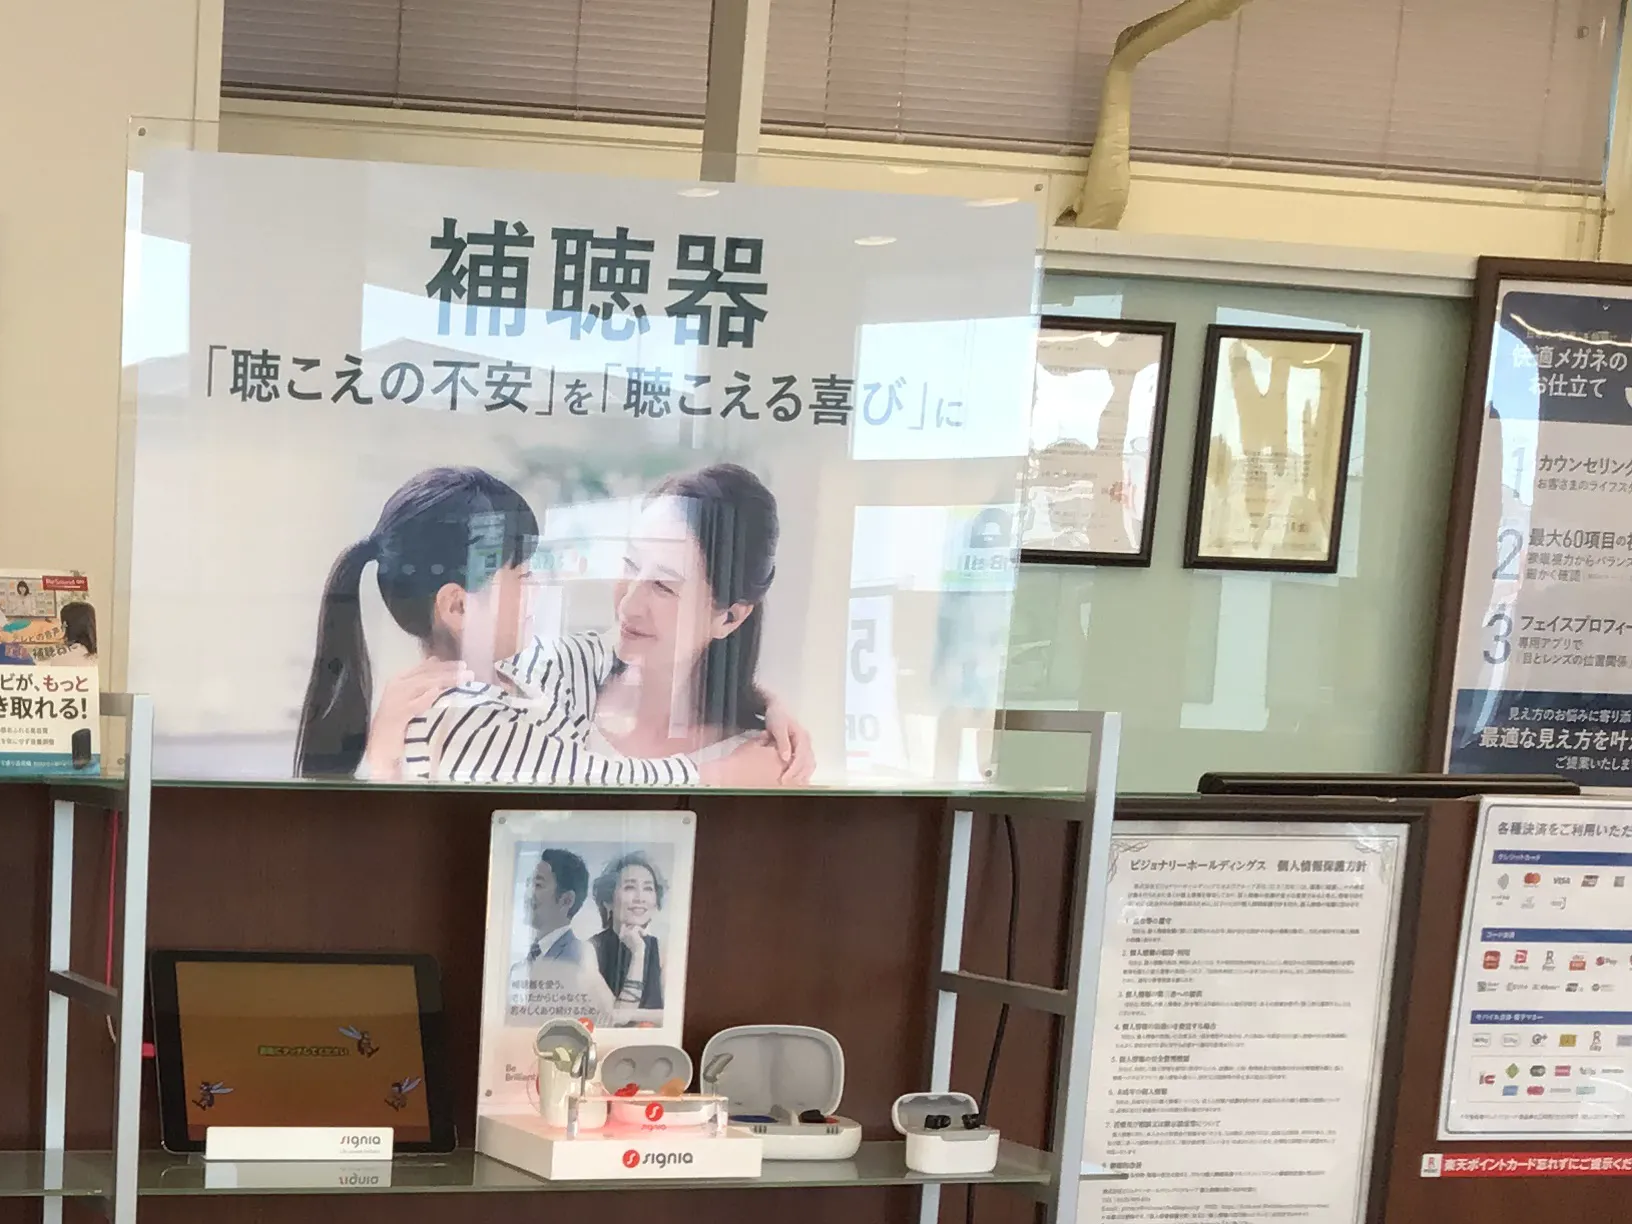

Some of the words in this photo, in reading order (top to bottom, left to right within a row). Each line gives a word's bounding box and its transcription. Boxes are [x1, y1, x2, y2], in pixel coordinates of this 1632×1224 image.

[426, 217, 768, 349] 補聴器
[1513, 346, 1628, 372] 快適メガネの
[208, 347, 963, 431] 「聴こえの不安」を「聴こえる喜び」に
[1529, 375, 1607, 398] お仕立て
[1492, 529, 1523, 580] 2
[1483, 612, 1514, 665] 3
[1519, 637, 1584, 650] 専用アプリで
[1130, 859, 1267, 872] ビジョナリーホールディングス
[340, 1135, 381, 1148] signia
[642, 1152, 693, 1168] signia
